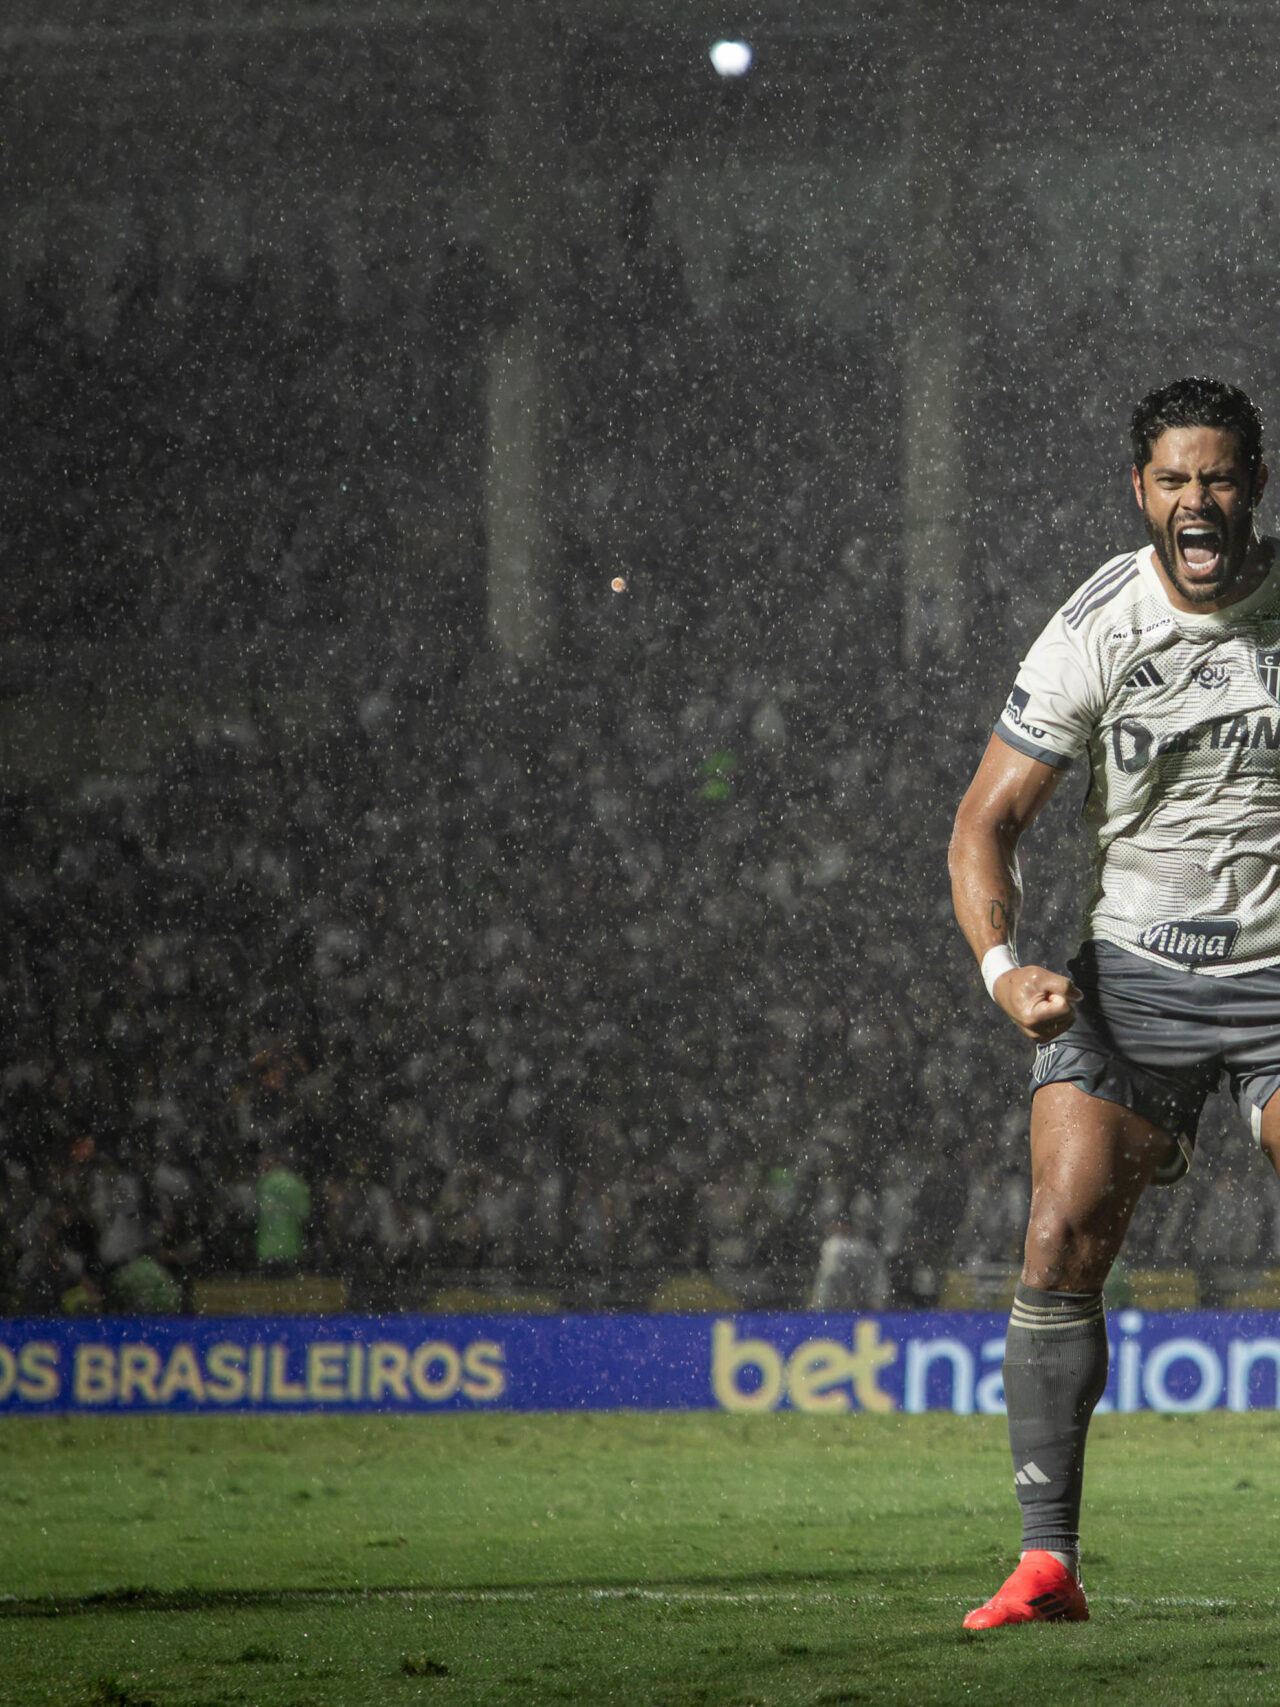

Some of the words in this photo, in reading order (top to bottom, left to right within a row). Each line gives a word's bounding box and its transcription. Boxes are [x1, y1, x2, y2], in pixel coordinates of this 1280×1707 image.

[1143, 924, 1227, 957] Vilma
[0, 1342, 60, 1401] S
[74, 1341, 507, 1402] BRASILEIROS
